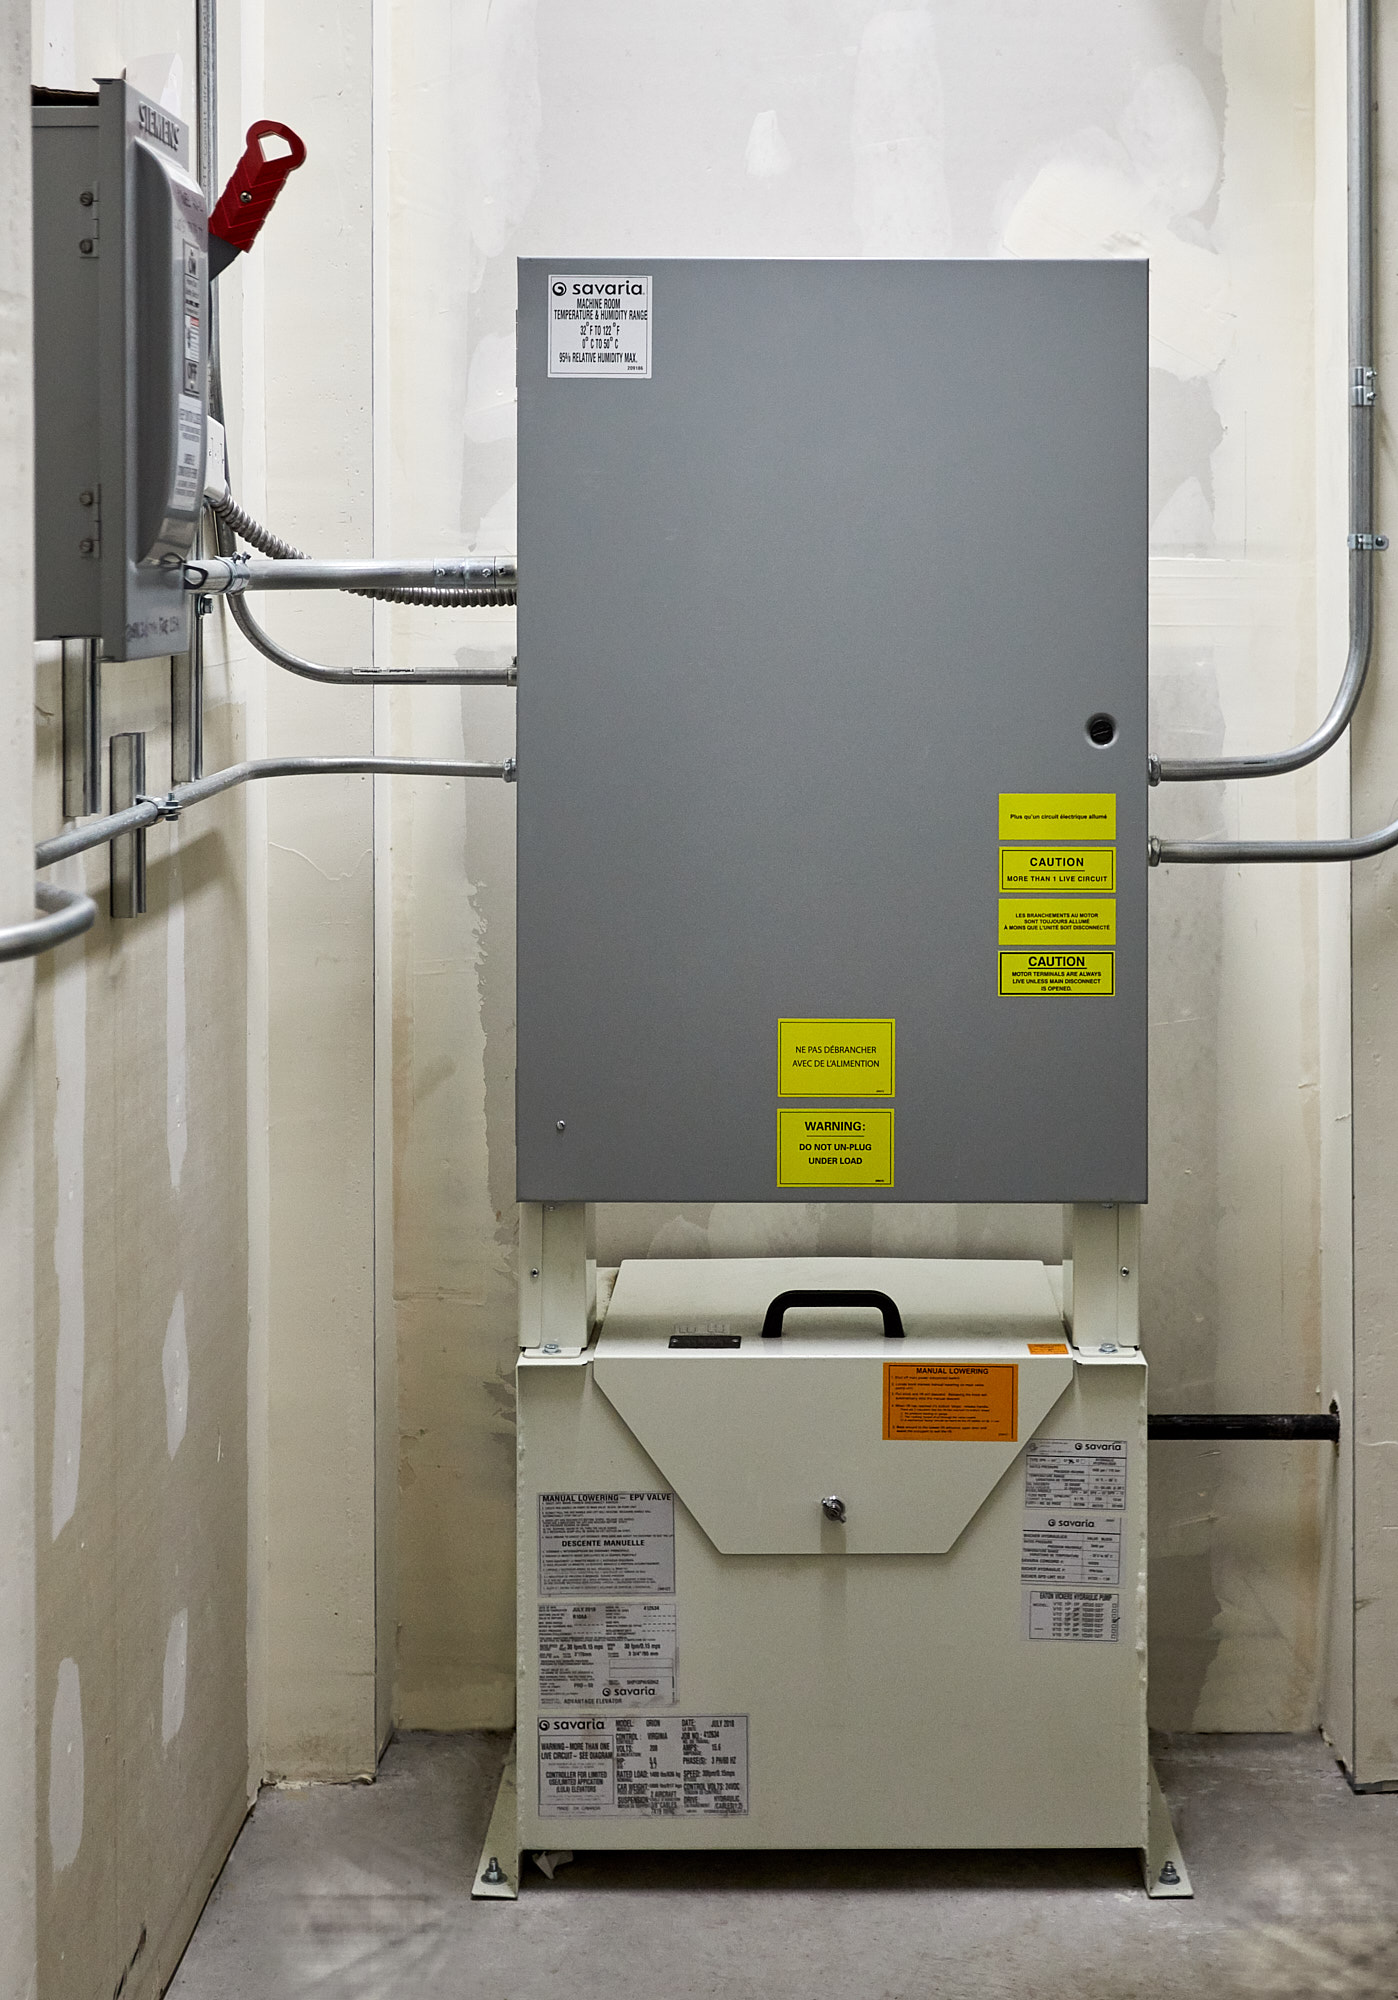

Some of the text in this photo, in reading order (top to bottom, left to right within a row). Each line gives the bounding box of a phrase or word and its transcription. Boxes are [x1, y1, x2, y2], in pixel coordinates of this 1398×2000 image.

[139, 101, 179, 152] SIEMENS
[572, 280, 642, 295] savaria
[577, 299, 620, 309] MACHINE ROOM
[554, 310, 647, 320] TEMPERATURE & HUMIDITY RANGE
[595, 325, 601, 335] TO
[596, 339, 602, 349] TO
[559, 353, 637, 362] 95% RELATIVE HUMIDITY MAX.
[1030, 858, 1084, 867] CAUTION
[1028, 956, 1085, 966] CAUTION
[824, 1044, 877, 1053] DÉBRANCHER
[805, 1121, 866, 1131] WARNING:
[542, 1494, 575, 1502] MANUAL
[646, 1493, 671, 1501] VALVE
[1058, 1519, 1094, 1527] savaria
[614, 1686, 655, 1696] savaria
[553, 1718, 605, 1730] savaria
[541, 1742, 565, 1750] WARNING
[569, 1742, 583, 1750] MORE
[585, 1742, 598, 1750] THAN
[600, 1742, 610, 1750] ONE
